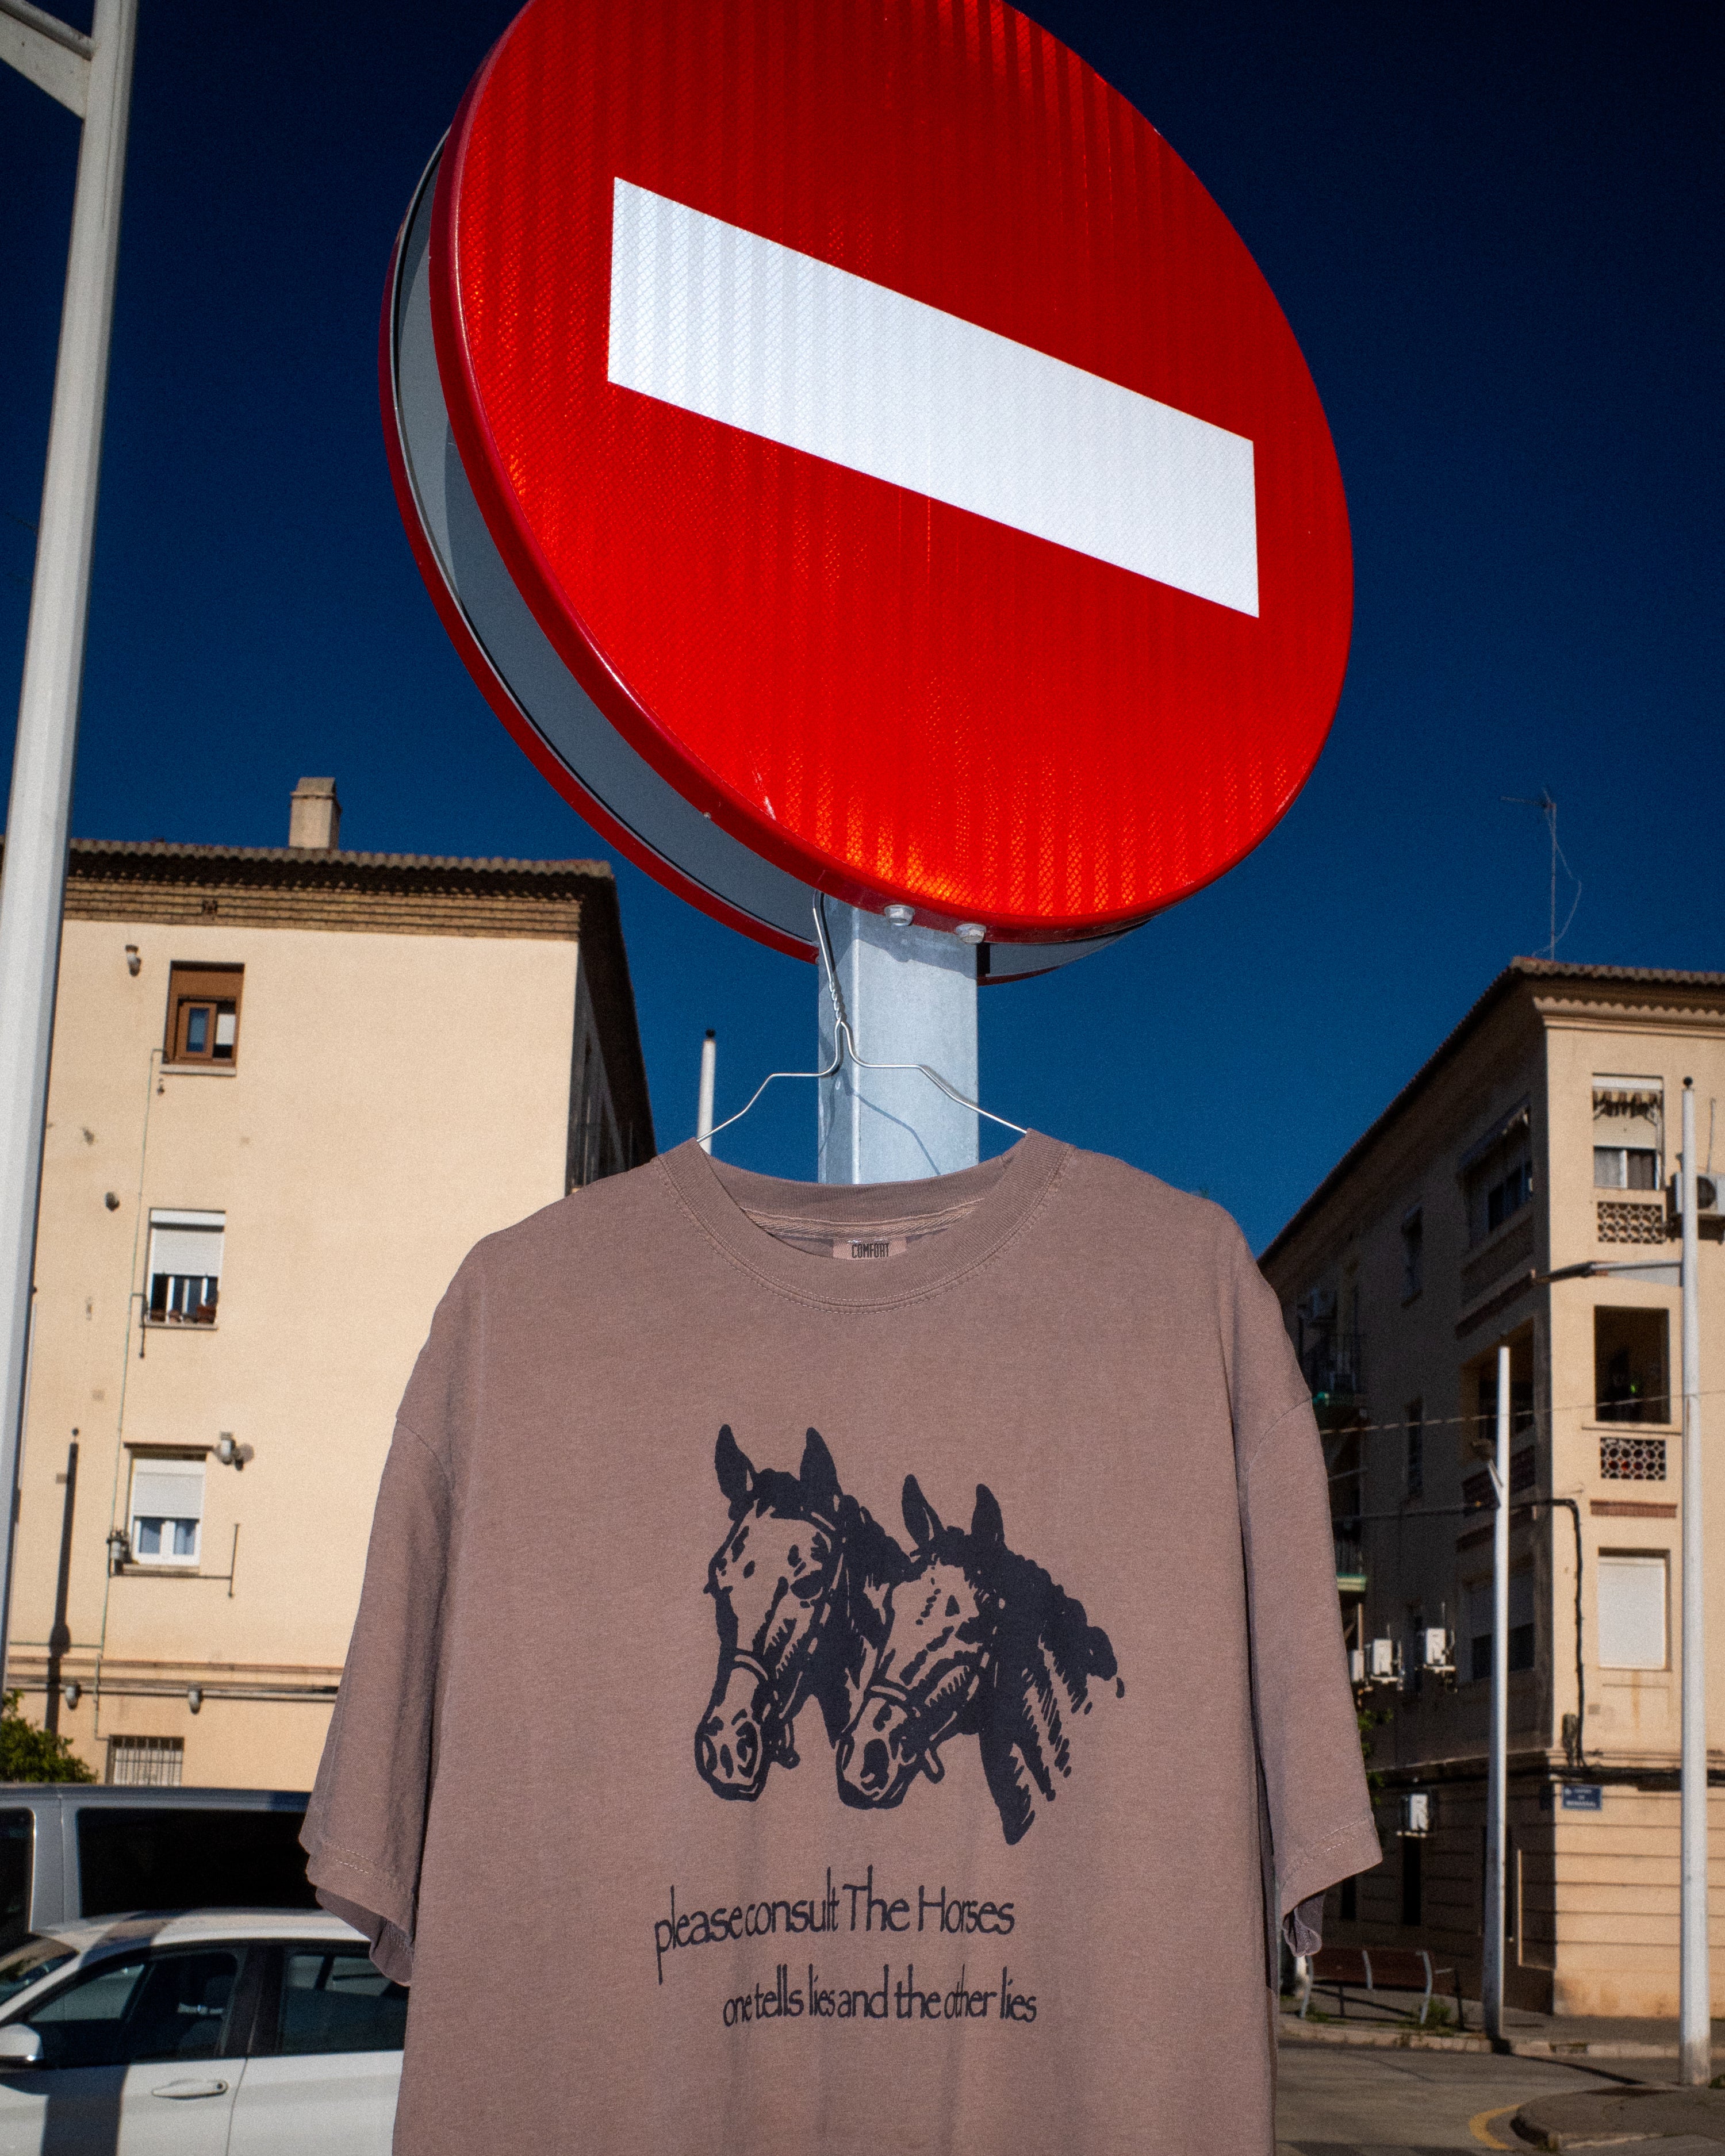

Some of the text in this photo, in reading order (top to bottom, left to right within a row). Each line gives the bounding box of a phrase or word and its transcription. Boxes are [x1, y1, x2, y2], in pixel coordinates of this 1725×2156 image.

[851, 1242, 890, 1259] COMFORT
[654, 1864, 1015, 1986] please consult The Horses
[723, 1963, 1037, 2027] one tells lies and the other lies
